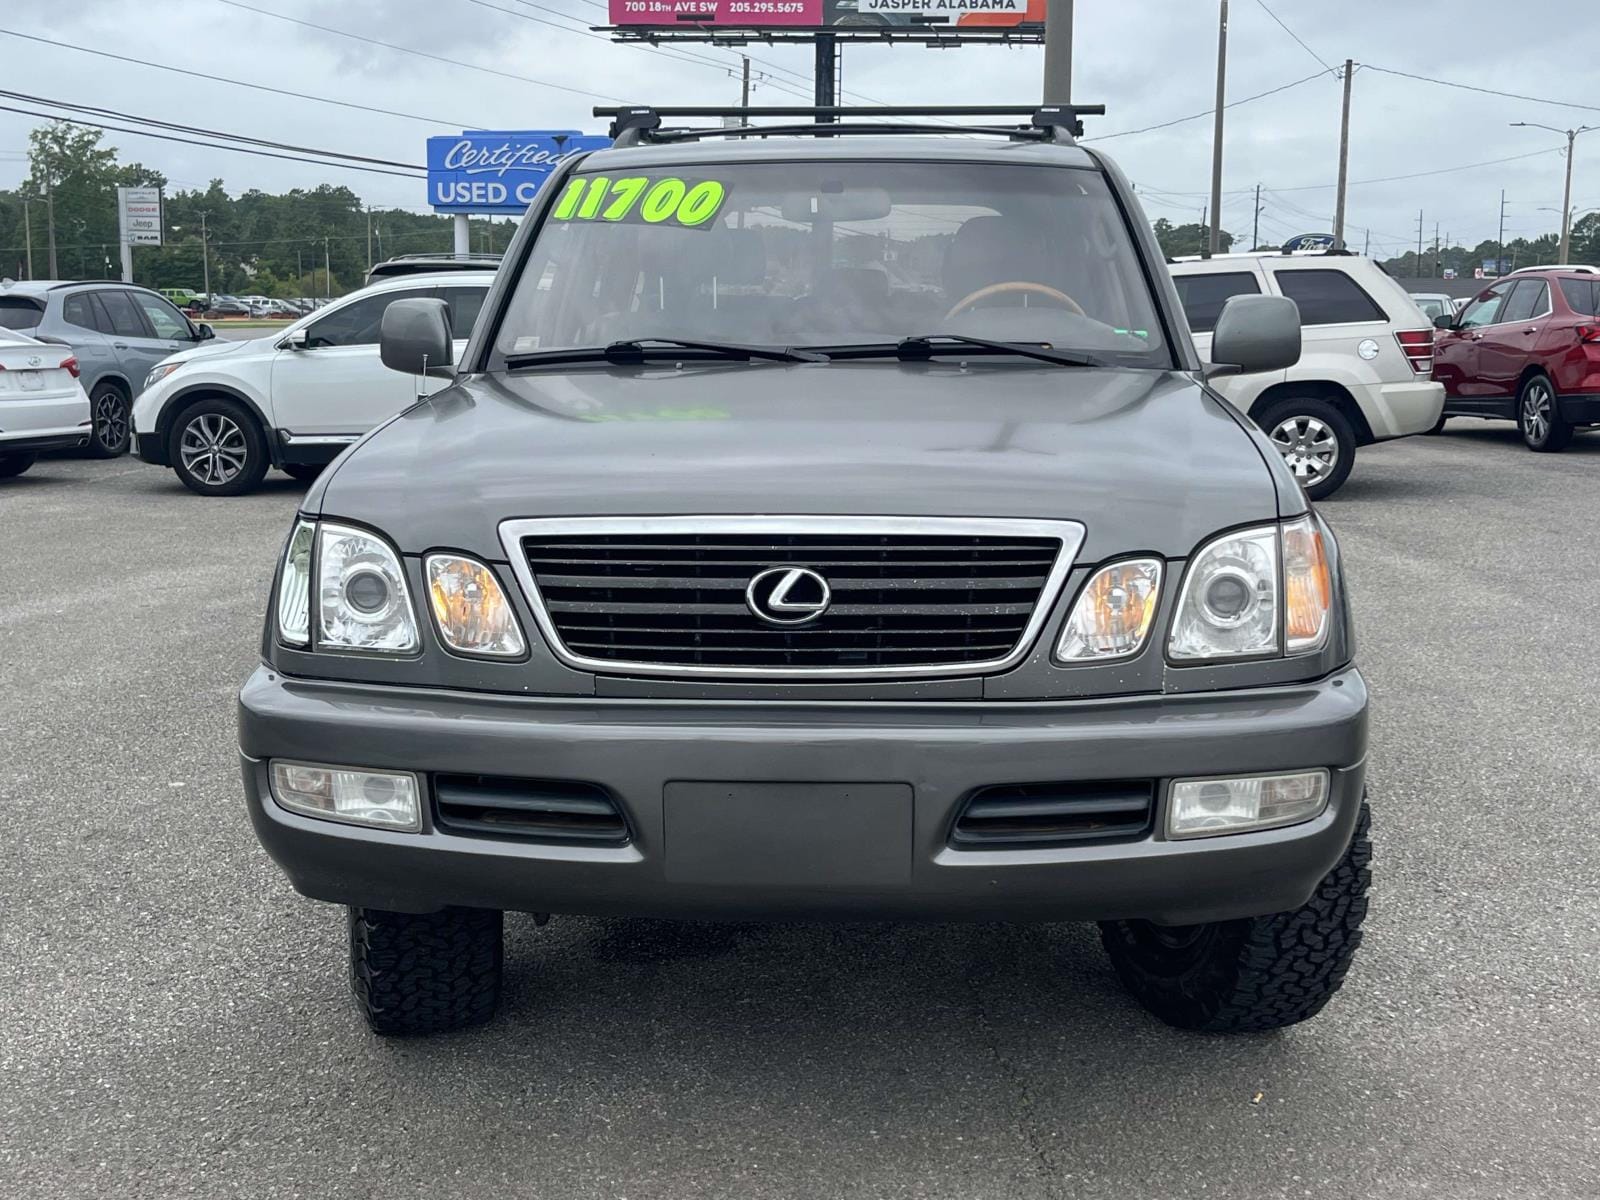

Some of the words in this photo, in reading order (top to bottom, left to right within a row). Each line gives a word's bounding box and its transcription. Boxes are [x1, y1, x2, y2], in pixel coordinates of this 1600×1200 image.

[625, 1, 646, 12] 700
[674, 1, 696, 12] AVE
[699, 1, 718, 12] SW
[729, 2, 804, 13] 205.295.5675
[869, 0, 932, 9] JASPER
[936, 0, 1016, 9] ALABAMA
[444, 140, 582, 177] Certified
[437, 182, 507, 203] USED
[553, 177, 725, 226] 11700
[132, 219, 153, 228] Jeep
